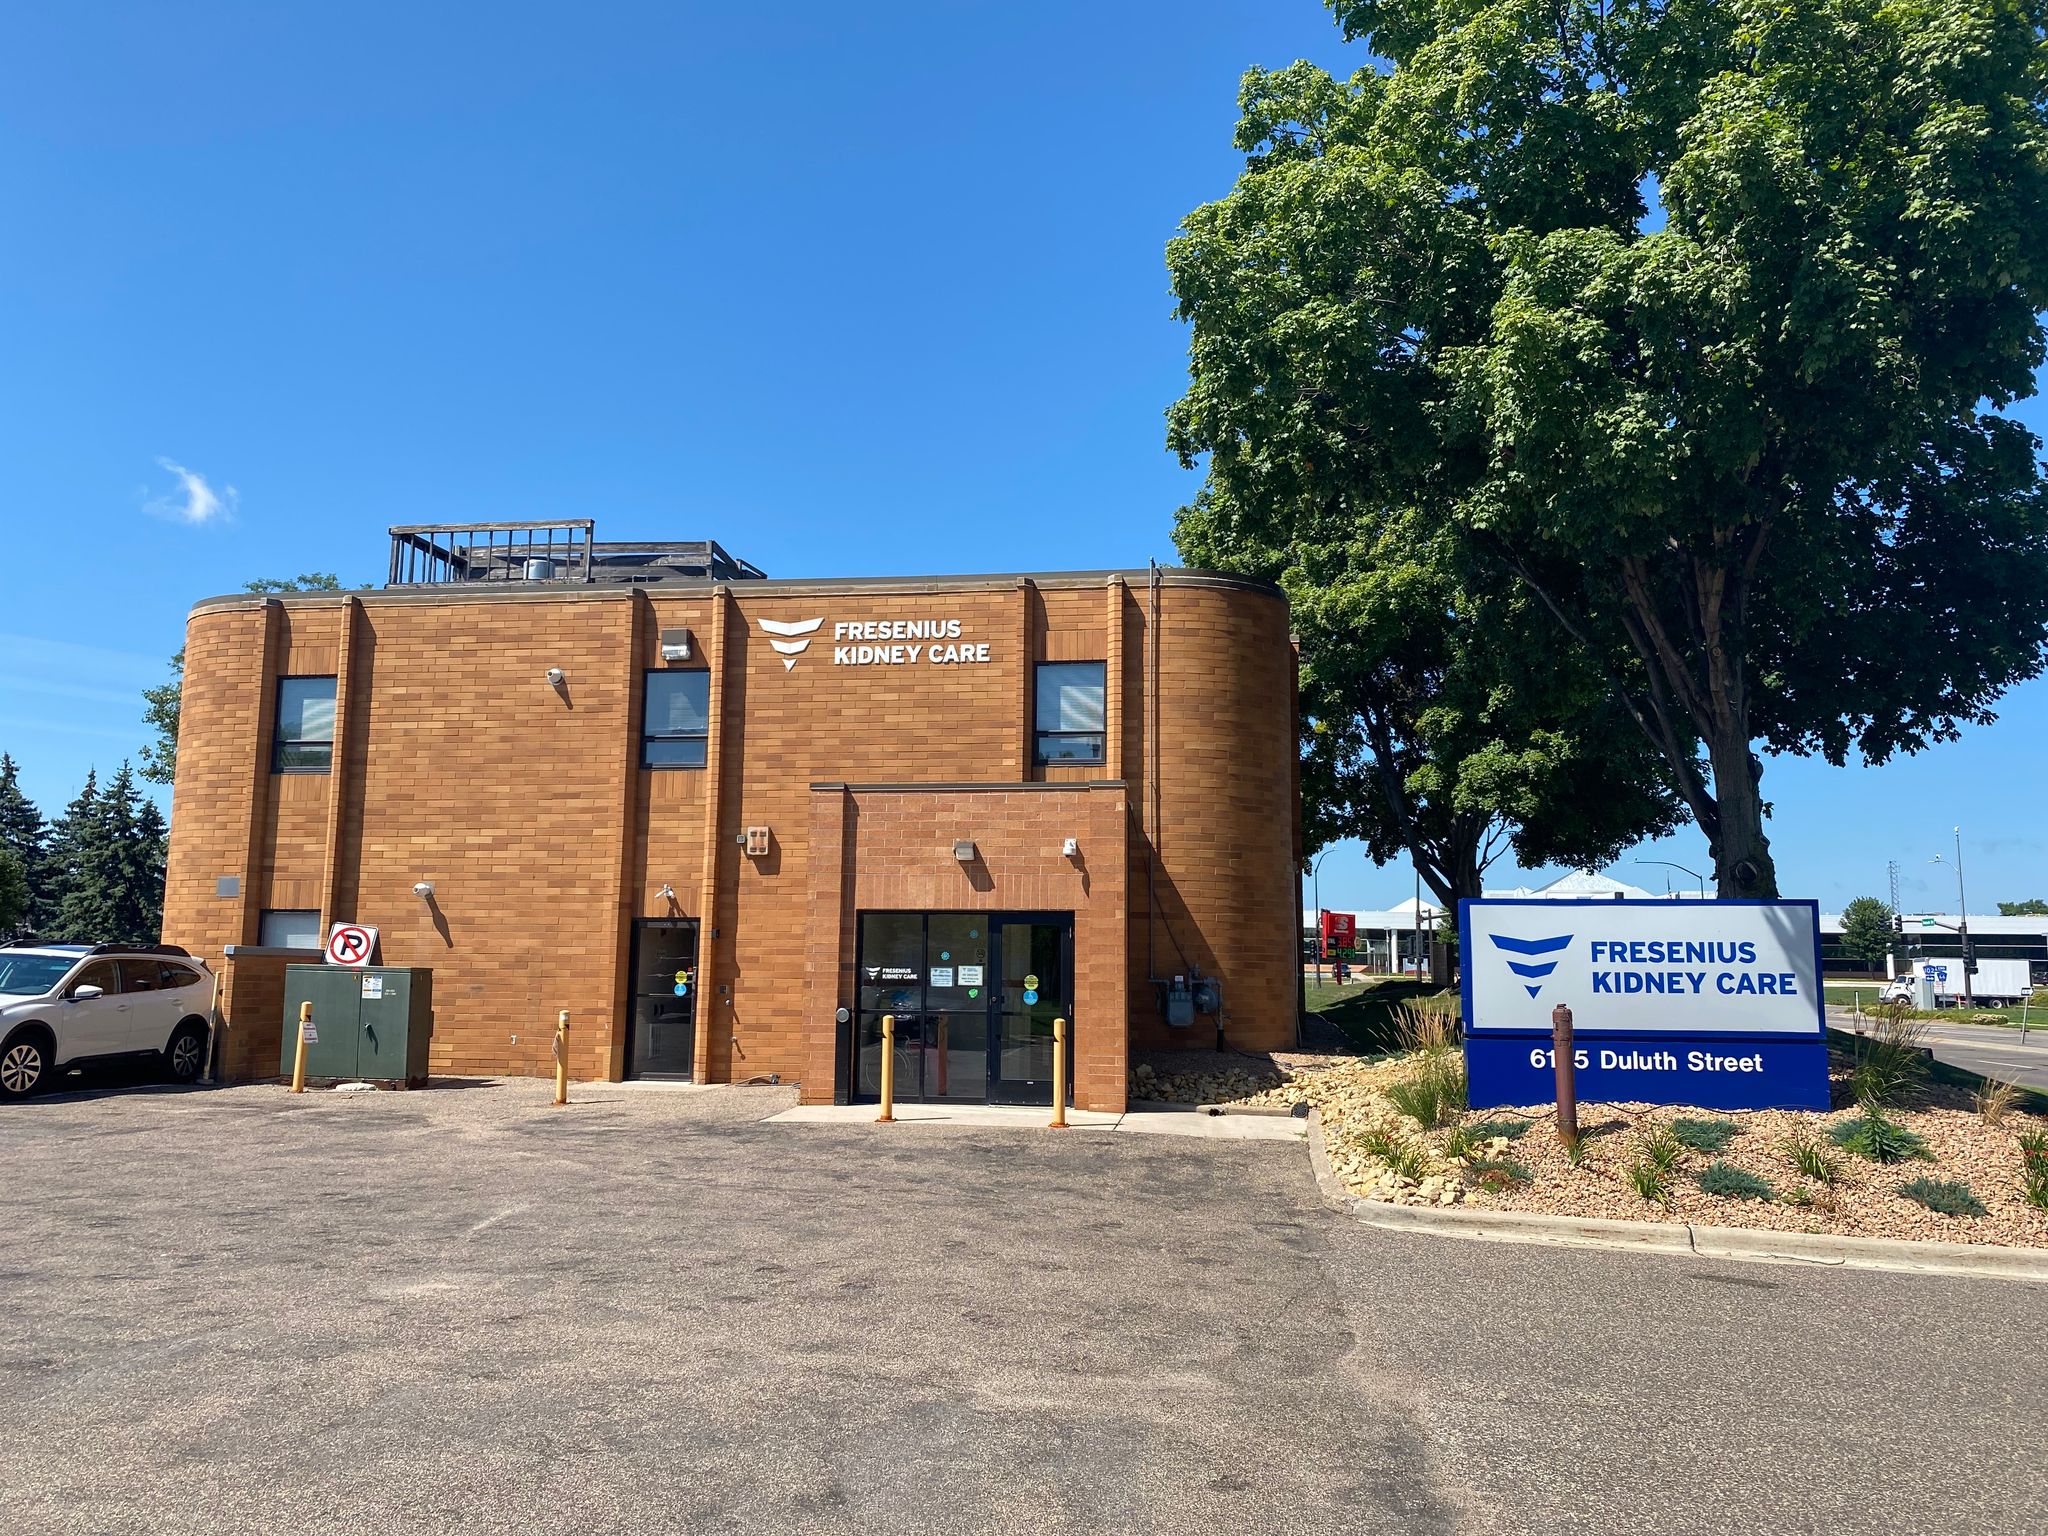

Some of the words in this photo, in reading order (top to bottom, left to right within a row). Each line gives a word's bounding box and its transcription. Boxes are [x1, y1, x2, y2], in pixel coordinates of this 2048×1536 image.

[835, 620, 962, 641] FRESENIUS
[834, 645, 923, 665] KIDNEY
[928, 644, 991, 664] CARE
[1591, 941, 1757, 964] FRESENIUS
[1592, 972, 1706, 994] KIDNEY
[1716, 973, 1798, 995] CARE
[1530, 1049, 1589, 1069] 615
[1600, 1050, 1678, 1070] Duluth
[1687, 1052, 1764, 1072] Street
